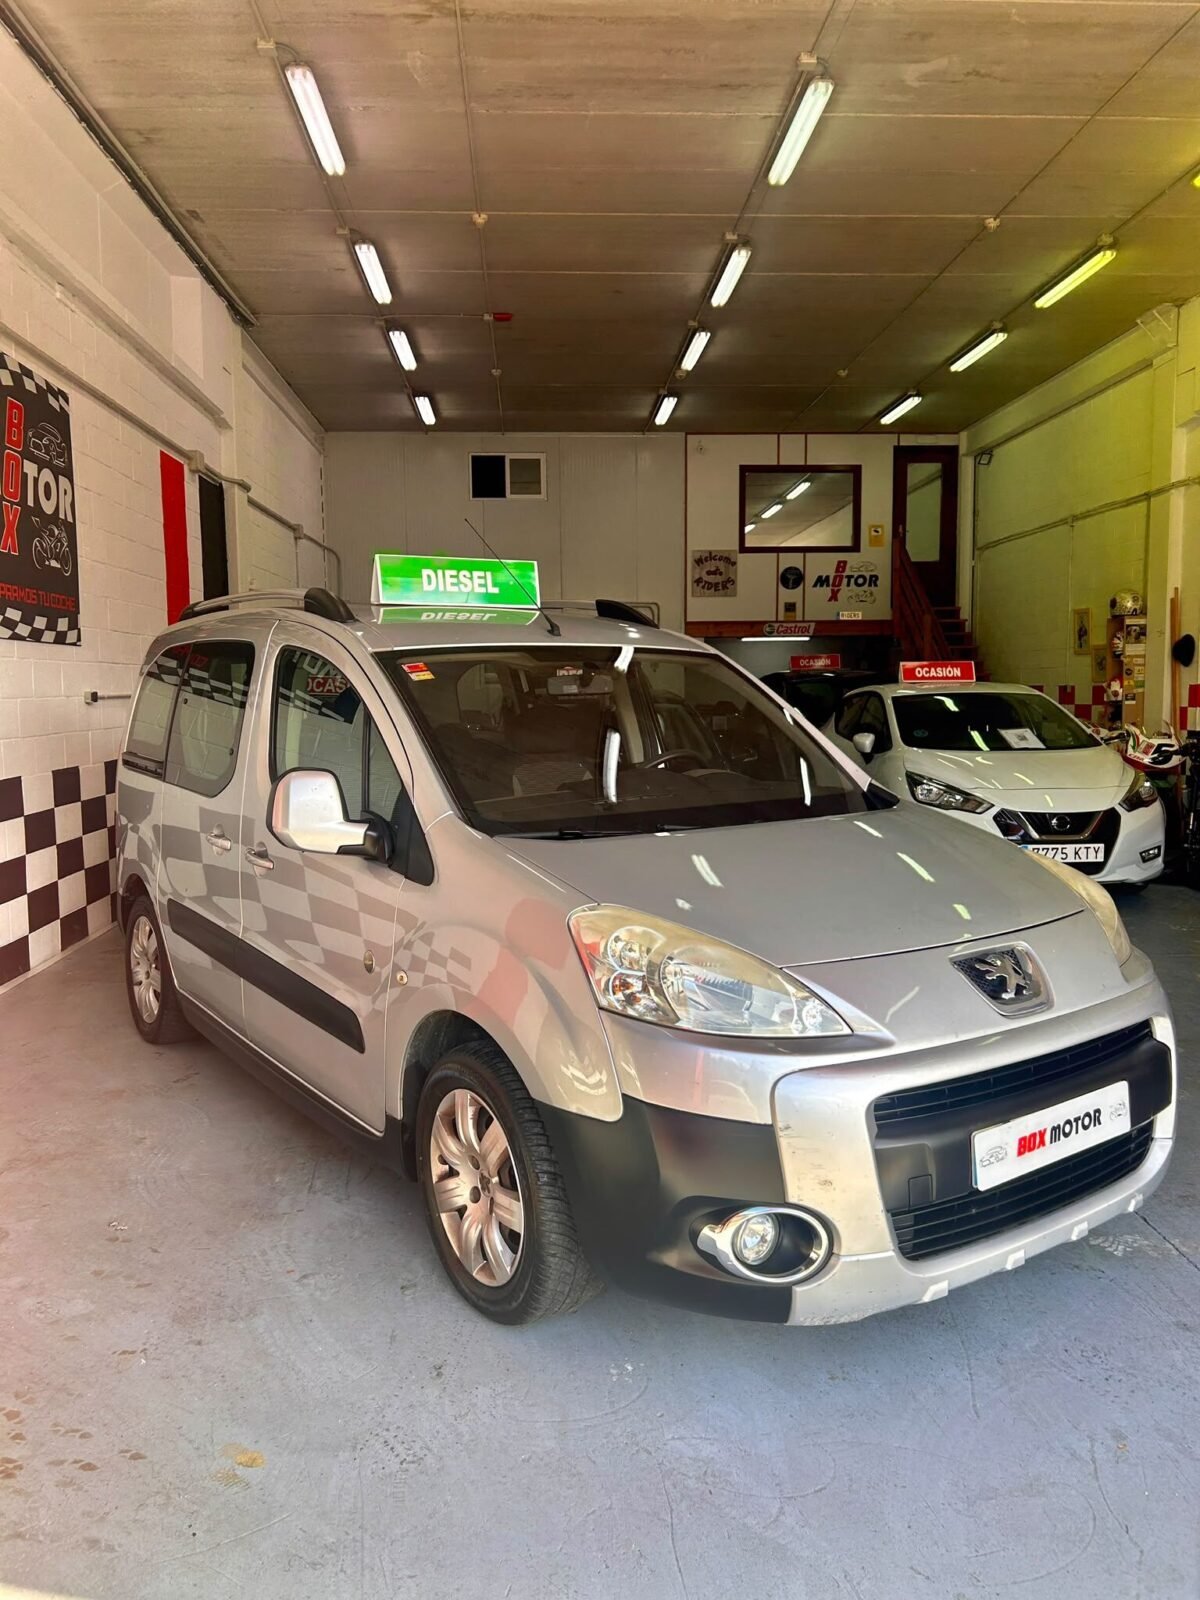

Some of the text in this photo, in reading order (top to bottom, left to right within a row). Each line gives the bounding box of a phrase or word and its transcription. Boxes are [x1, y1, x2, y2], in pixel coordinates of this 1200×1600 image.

[0, 397, 24, 555] BOX
[693, 551, 737, 567] Welcome
[421, 568, 499, 593] DIESEL
[693, 576, 736, 592] RIDERS
[812, 574, 879, 588] MOTOR
[827, 560, 848, 602] BOX
[50, 593, 76, 611] COCHE
[776, 624, 811, 635] Castrol
[915, 664, 961, 678] OCASIÓN
[1074, 846, 1101, 860] KTY
[1016, 1108, 1102, 1158] BOX MOTOR
